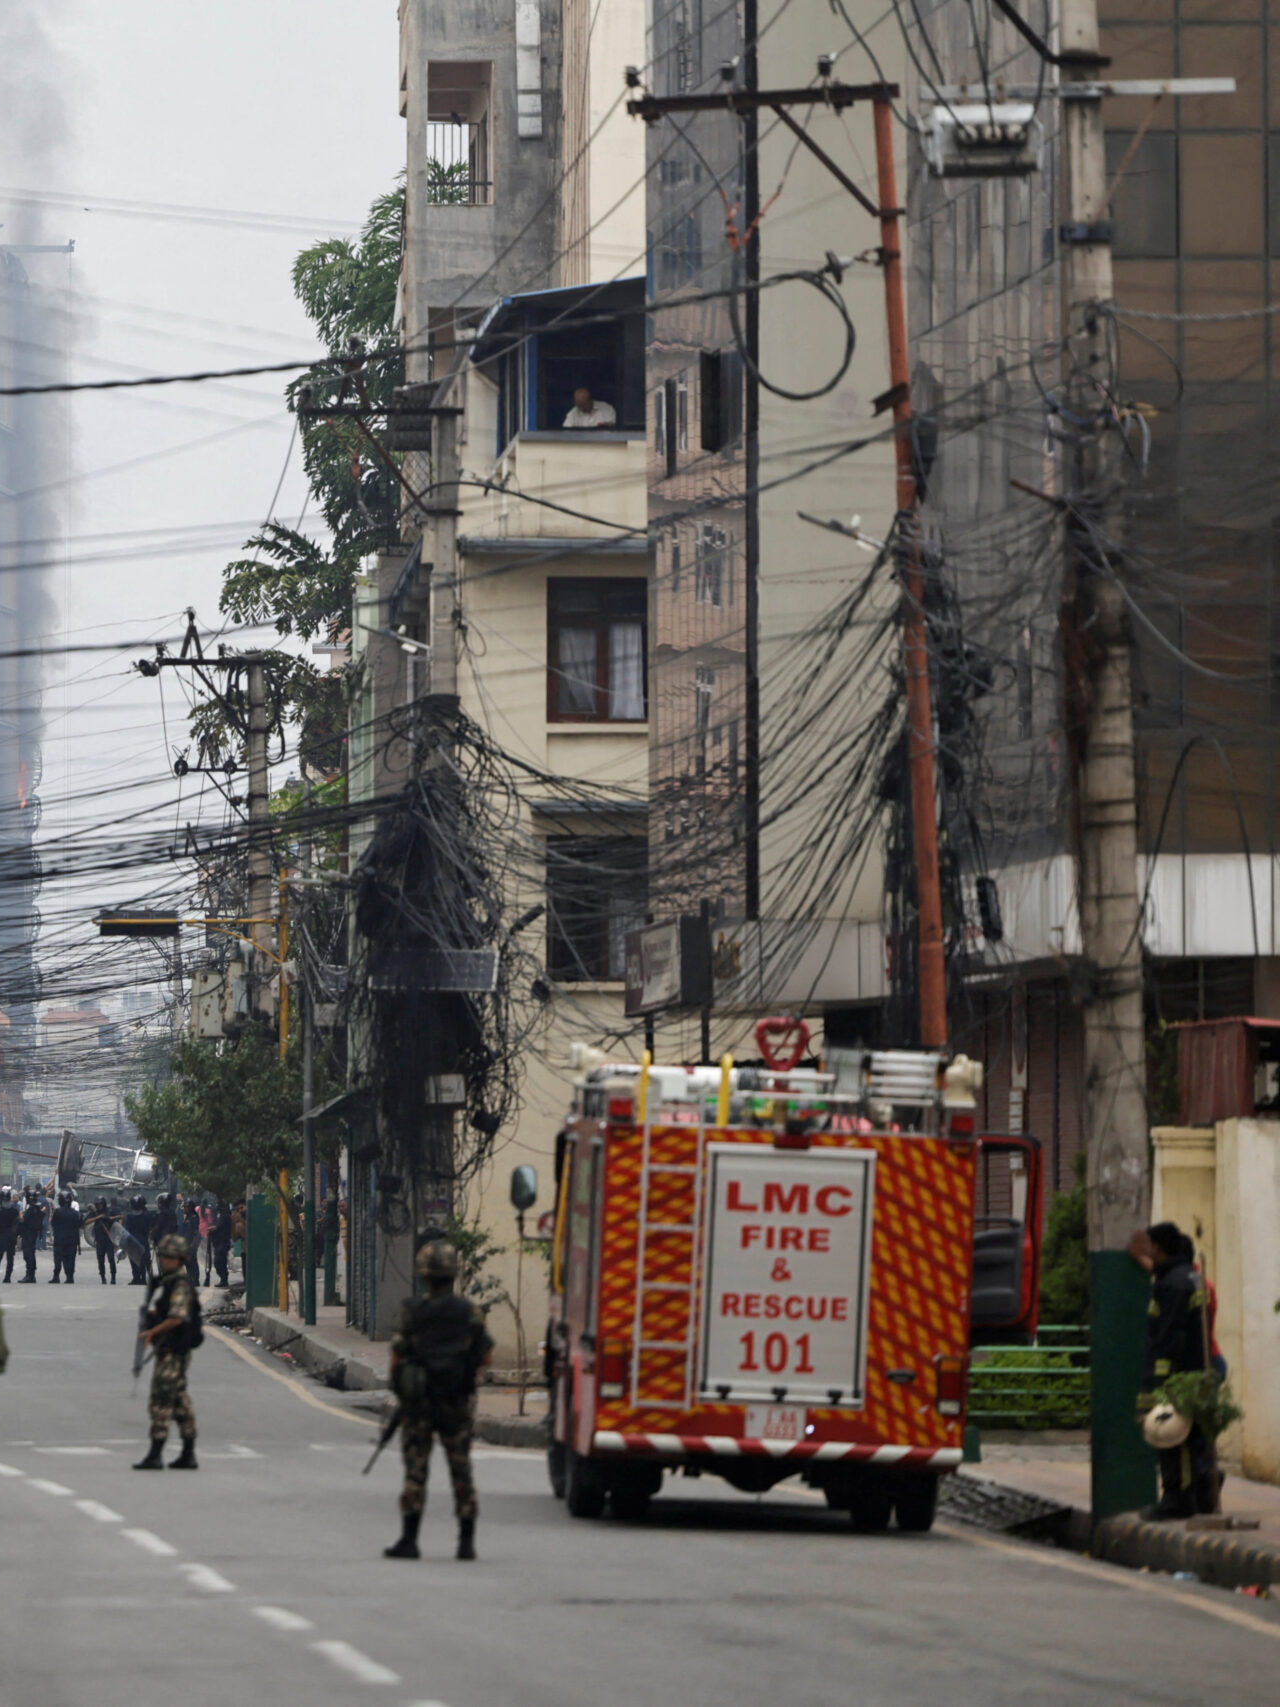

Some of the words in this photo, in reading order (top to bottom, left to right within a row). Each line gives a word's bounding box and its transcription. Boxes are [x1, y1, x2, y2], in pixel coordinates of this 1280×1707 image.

[726, 1181, 853, 1217] LMC
[740, 1225, 831, 1252] FIRE
[770, 1257, 792, 1282] &
[721, 1292, 848, 1321] RESCUE
[738, 1330, 815, 1374] 101
